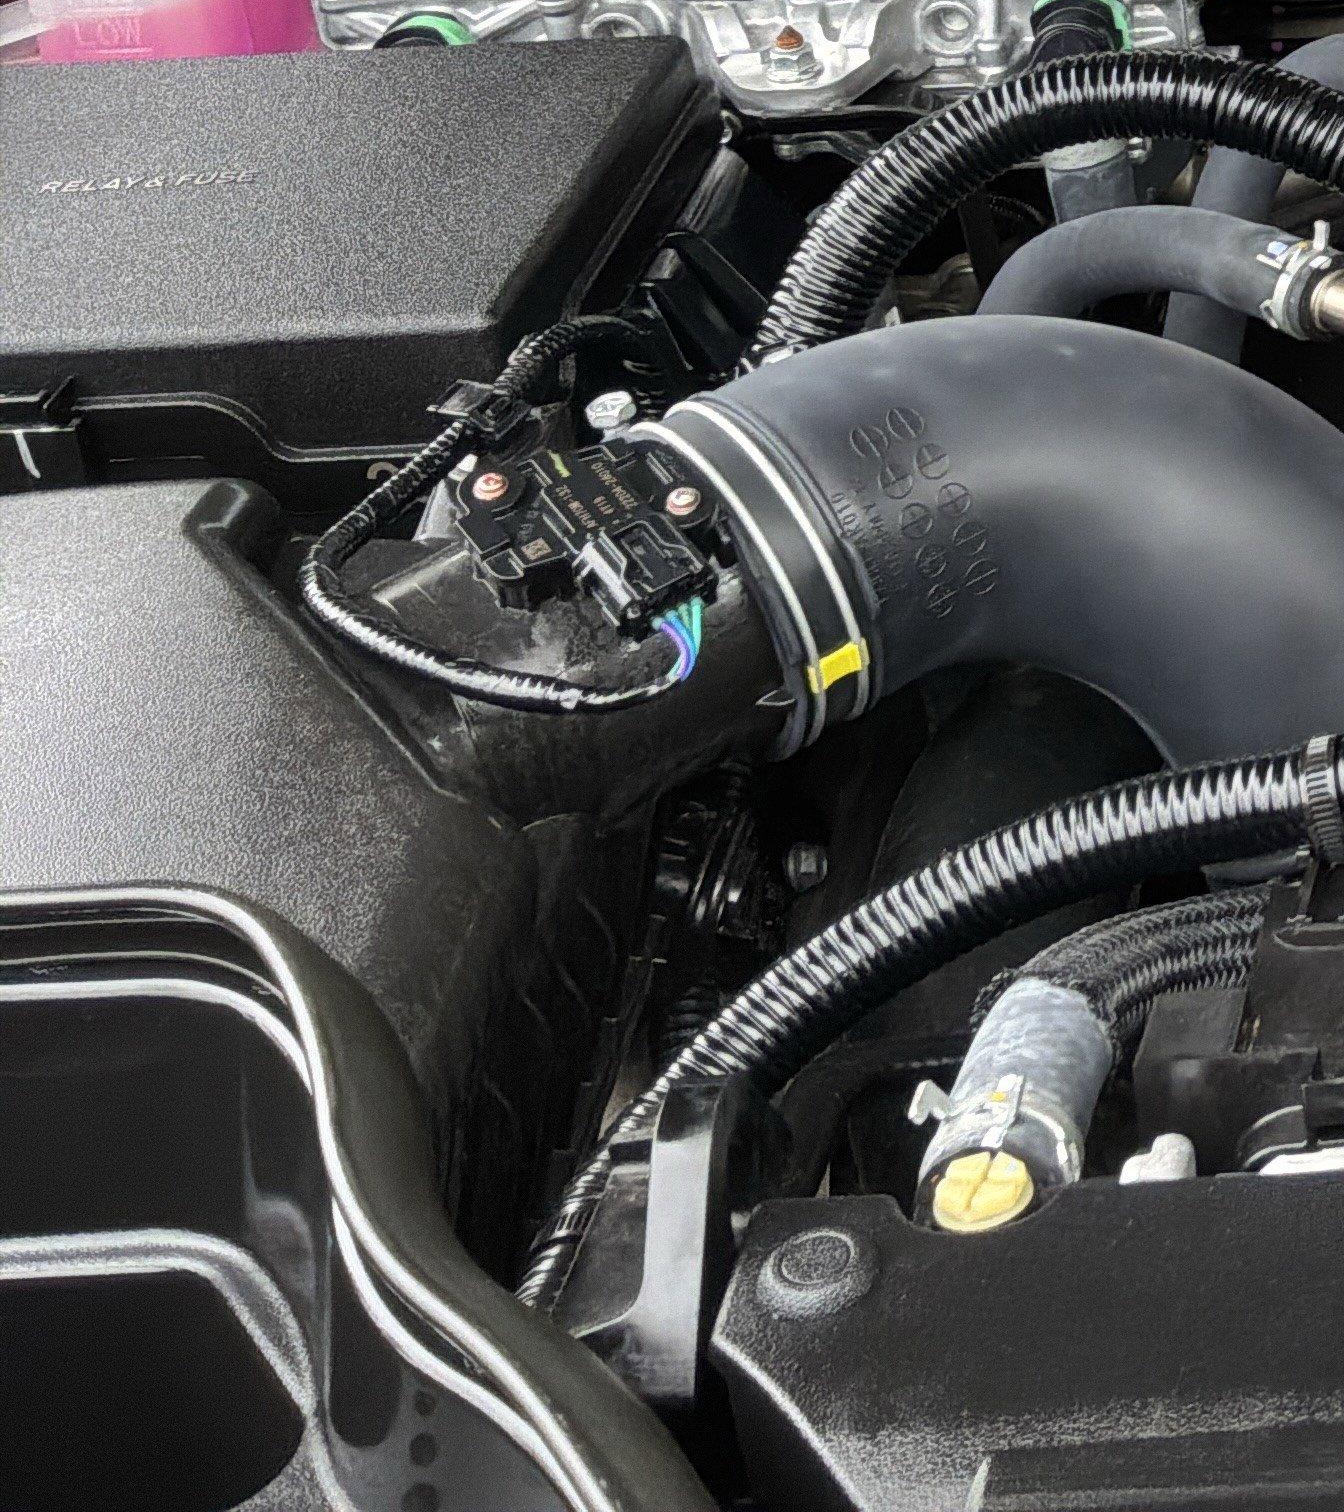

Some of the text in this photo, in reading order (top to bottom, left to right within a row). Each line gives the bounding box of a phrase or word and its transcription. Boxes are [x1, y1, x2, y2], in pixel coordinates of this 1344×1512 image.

[73, 13, 142, 47] LOW
[38, 176, 147, 194] RELAY
[174, 170, 262, 187] FUSE
